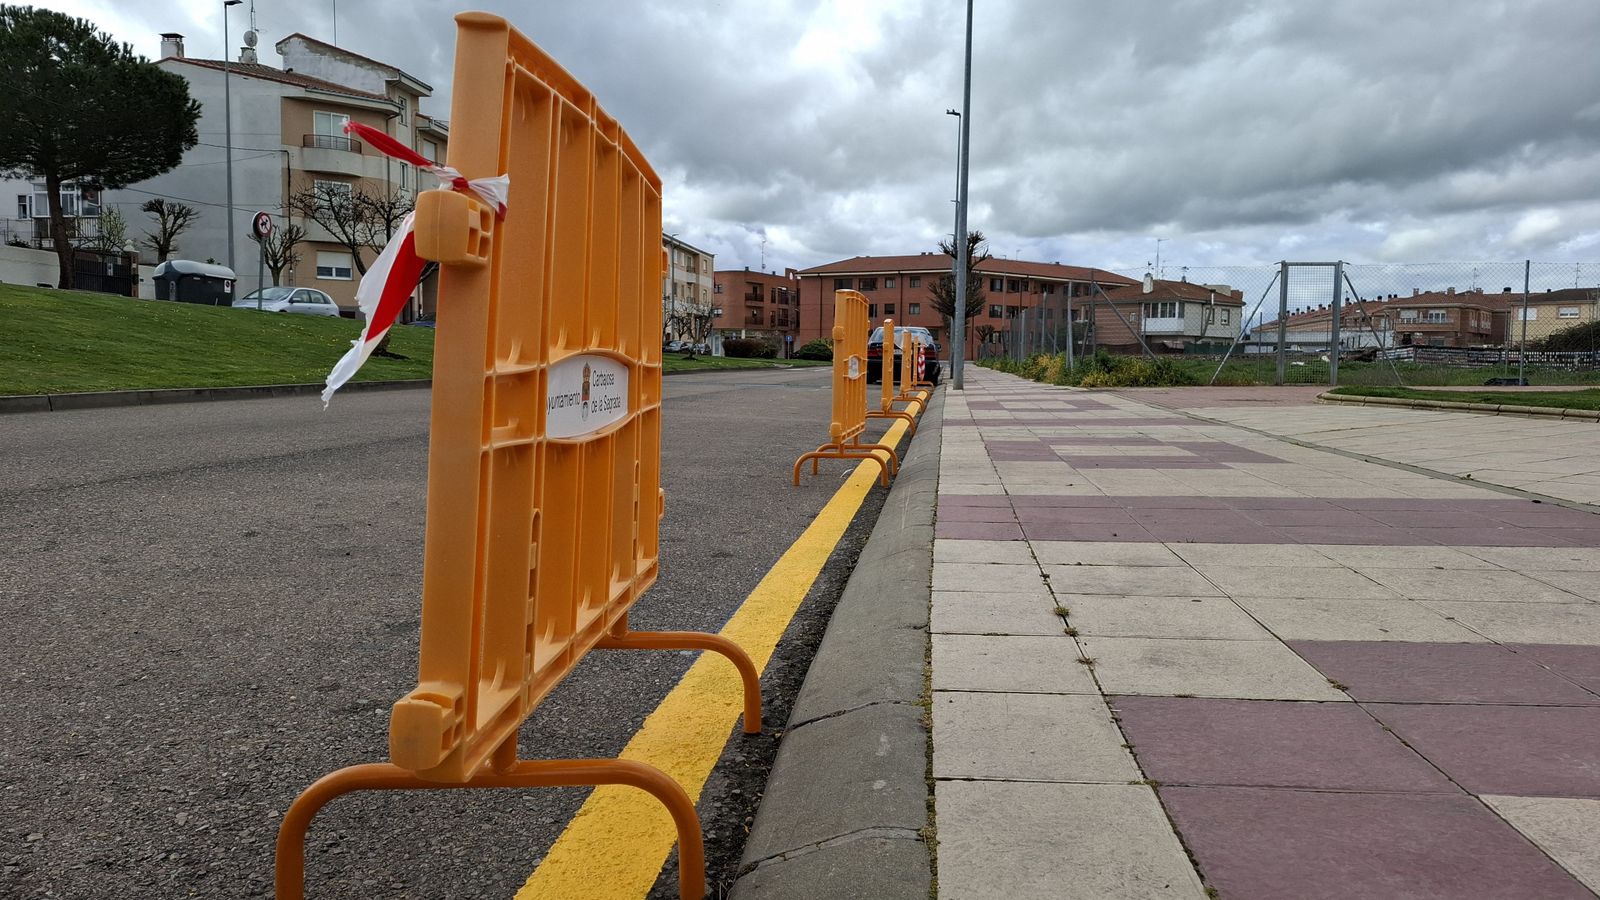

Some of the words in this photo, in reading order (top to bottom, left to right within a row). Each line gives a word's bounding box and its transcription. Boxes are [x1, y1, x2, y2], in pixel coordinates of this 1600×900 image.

[547, 390, 581, 415] yuntamiento
[591, 398, 598, 413] de
[603, 394, 621, 414] Sagrada
